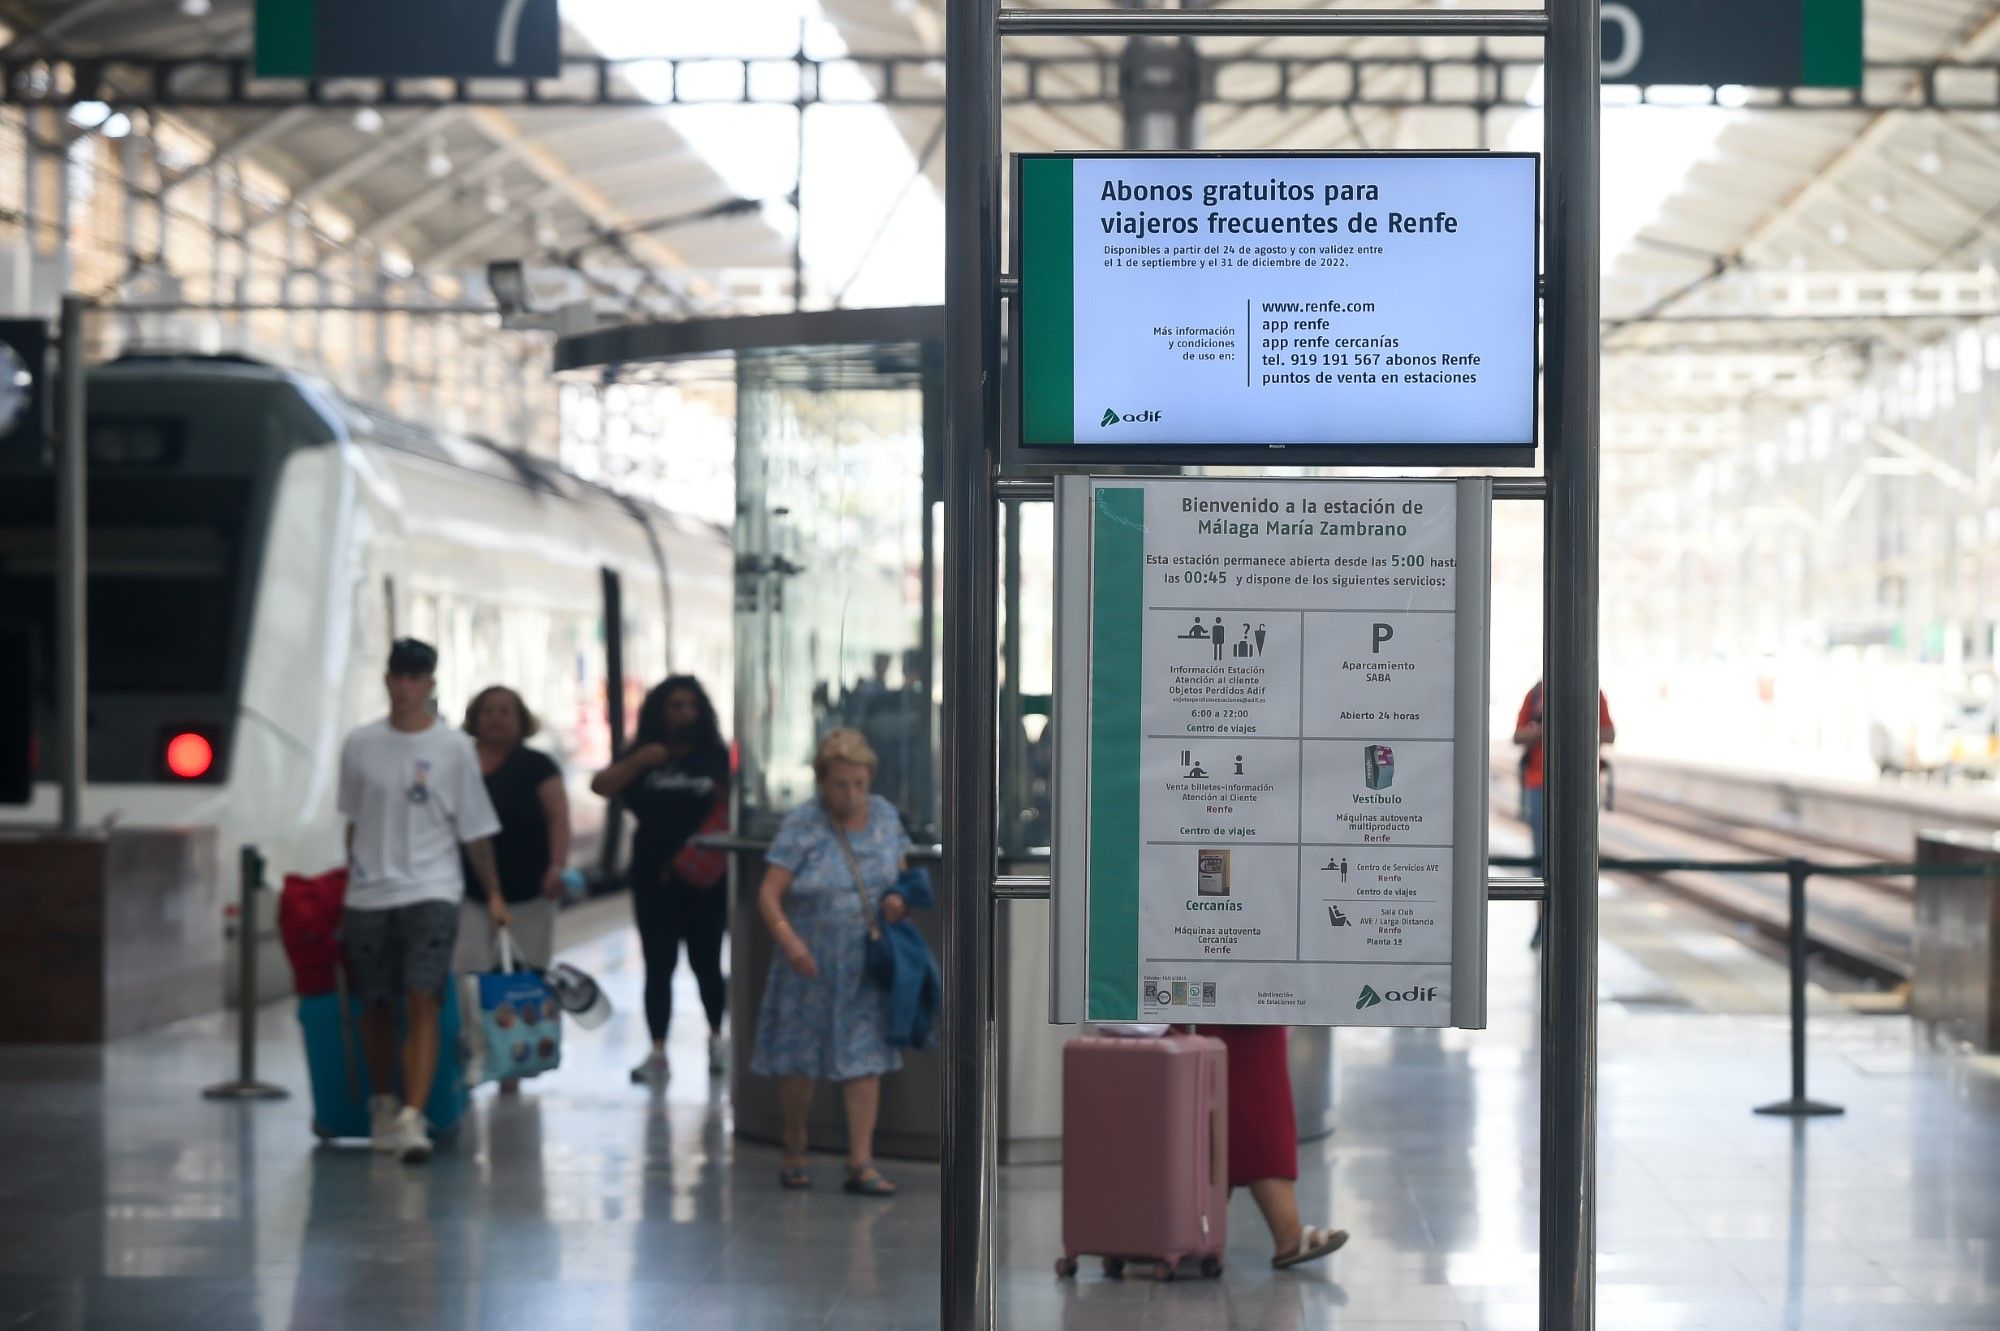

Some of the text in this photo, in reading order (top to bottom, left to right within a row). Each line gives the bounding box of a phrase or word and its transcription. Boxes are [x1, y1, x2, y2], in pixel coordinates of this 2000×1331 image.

[1101, 178, 1379, 206] Abonos gratuitos para
[1101, 211, 1457, 239] viajeros frecuentes de Renfe
[1104, 245, 1161, 256] Disponibles
[1173, 245, 1201, 256] partir
[1204, 245, 1219, 254] del
[1223, 245, 1235, 254] 24
[1239, 245, 1251, 254] de
[1254, 246, 1287, 256] agosto
[1290, 247, 1296, 256] y
[1319, 245, 1354, 254] validez
[1357, 246, 1383, 254] entre
[1104, 257, 1348, 269] el 1 de septiembre y el 31 de diciembre de 2022.
[1262, 300, 1375, 312] www.renfe.com
[1153, 326, 1235, 335] Más información
[1262, 318, 1329, 333] app renfe
[1168, 338, 1235, 350] y condiciones
[1262, 335, 1399, 351] app renfe cercanías
[1183, 351, 1195, 360] de
[1262, 353, 1480, 366] tel. 919 191 567 abonos Renfe
[1263, 371, 1476, 386] puntos de venta en estaciones
[1122, 410, 1162, 422] adif
[1182, 497, 1423, 514] Bienvenido a la estación de
[1199, 518, 1407, 537] Málaga María Zambrano
[1146, 554, 1168, 564] Esta
[1173, 554, 1219, 565] estación
[1224, 557, 1286, 567] permanece
[1290, 555, 1330, 566] abierta
[1334, 556, 1367, 566] desde
[1371, 557, 1387, 567] las
[1392, 554, 1424, 567] 5:00
[1165, 571, 1445, 587] las 00:45 y dispone de los siguientes servicios:
[1372, 623, 1393, 653] P
[1170, 665, 1265, 674] Información Estación
[1342, 661, 1415, 671] Aparcamiento
[1175, 676, 1259, 684] Atención al cliente
[1366, 673, 1391, 682] SABA
[1169, 686, 1265, 695] Objetos Perdidos Adif
[1191, 709, 1212, 718] 6:00
[1223, 710, 1248, 718] 22:00
[1340, 711, 1420, 720] Abierto 24 horas
[1187, 724, 1256, 734] Centro de viajes
[1166, 783, 1188, 791] Venta
[1182, 793, 1217, 801] Atención
[1230, 793, 1257, 801] Cliente
[1352, 794, 1402, 804] Vestíbulo
[1206, 805, 1233, 813] Renfe
[1336, 813, 1423, 824] Máquinas autoventa
[1180, 827, 1256, 837] Centro de viajes
[1349, 823, 1411, 832] multiproducto
[1364, 834, 1391, 842] Renfe
[1357, 863, 1380, 871] Centro
[1393, 864, 1424, 872] Servicios
[1425, 864, 1439, 872] AVE
[1395, 888, 1417, 897] viajes
[1186, 899, 1242, 911] Cercanías
[1381, 908, 1396, 916] Sala
[1380, 918, 1399, 927] Larga
[1402, 918, 1434, 927] Distancia
[1174, 926, 1261, 936] Máquinas autoventa
[1198, 936, 1238, 944] Cercanías
[1204, 945, 1231, 954] Renfe
[1385, 986, 1438, 1001] adif
